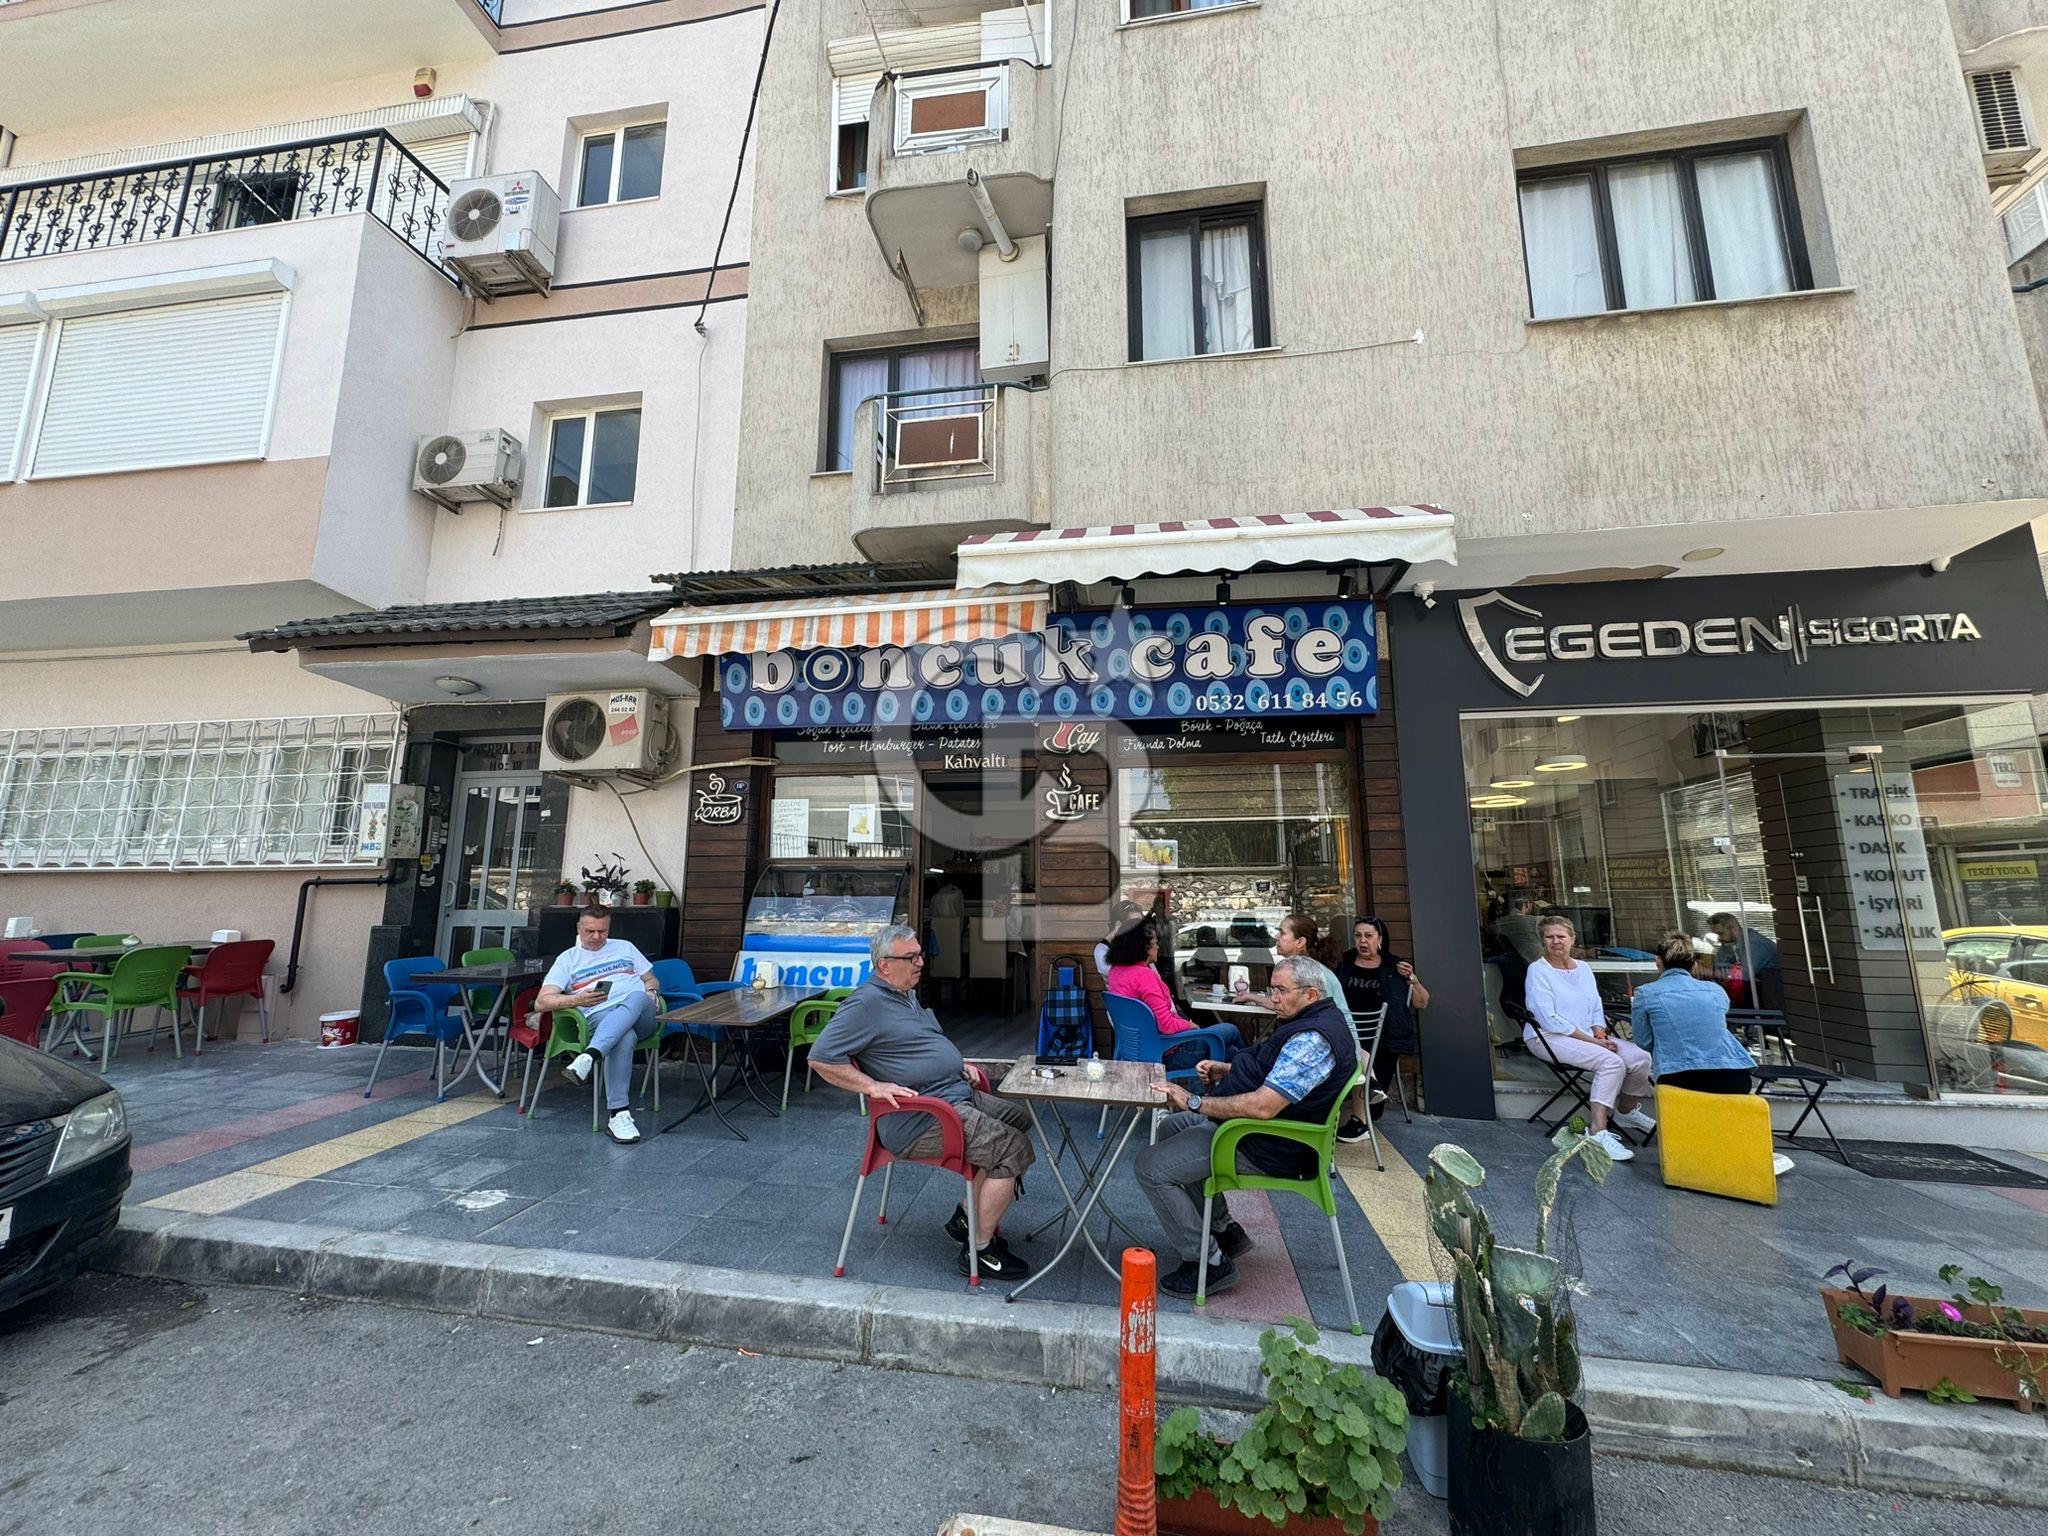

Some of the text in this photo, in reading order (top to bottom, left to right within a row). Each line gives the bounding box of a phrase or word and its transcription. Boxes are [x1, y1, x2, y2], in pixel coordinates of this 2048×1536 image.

[1505, 615, 1791, 662] EGEDEN
[750, 614, 1344, 694] boncuk cafe
[1196, 691, 1363, 711] 0532 611 84 56
[1180, 719, 1212, 733] Börek
[822, 740, 846, 753] Tost
[859, 737, 925, 756] Hamburger
[938, 736, 982, 749] Patates
[1166, 736, 1202, 749] Dolma
[944, 753, 1006, 769] Kahvaltı
[1069, 793, 1100, 811] CAFE
[694, 806, 737, 821] ÇORBA
[1995, 865, 2031, 877] YONCA
